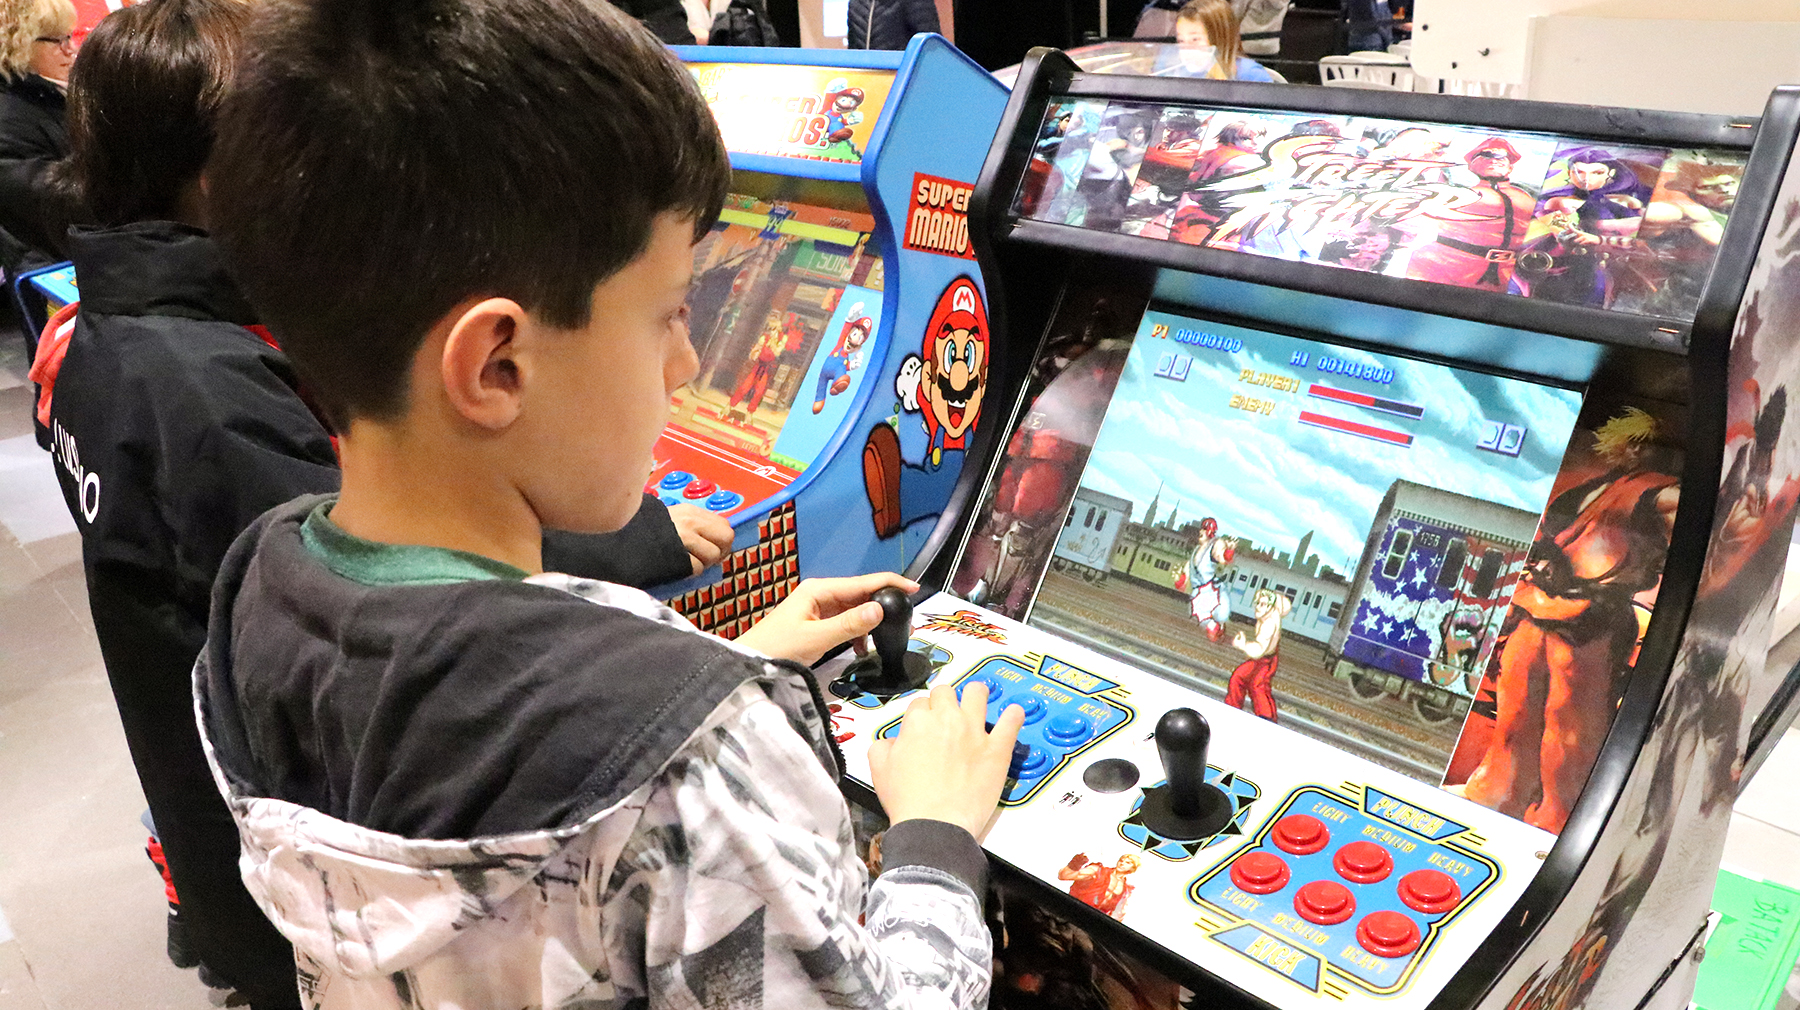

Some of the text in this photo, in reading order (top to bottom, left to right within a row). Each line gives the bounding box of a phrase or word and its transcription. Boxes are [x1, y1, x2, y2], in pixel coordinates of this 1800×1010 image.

[909, 207, 969, 254] MARIO
[1151, 324, 1243, 353] P1 00000100
[1290, 350, 1395, 385] HI 00141800
[1229, 394, 1276, 416] ENEMY
[995, 667, 1025, 684] LIGHT
[1043, 661, 1102, 692] PUNCH
[1031, 683, 1073, 704] MEDIUM
[1311, 801, 1351, 824] LIGHT
[1371, 796, 1445, 837] PUNCH
[1362, 824, 1417, 853] MEDIUM
[1428, 852, 1474, 877] HEAVY
[1220, 886, 1263, 912] LIGHT
[1272, 912, 1330, 945] MEDIUM
[1737, 897, 1789, 961] BATACK
[1245, 933, 1307, 976] KICK
[1340, 945, 1389, 974] HEAVY
